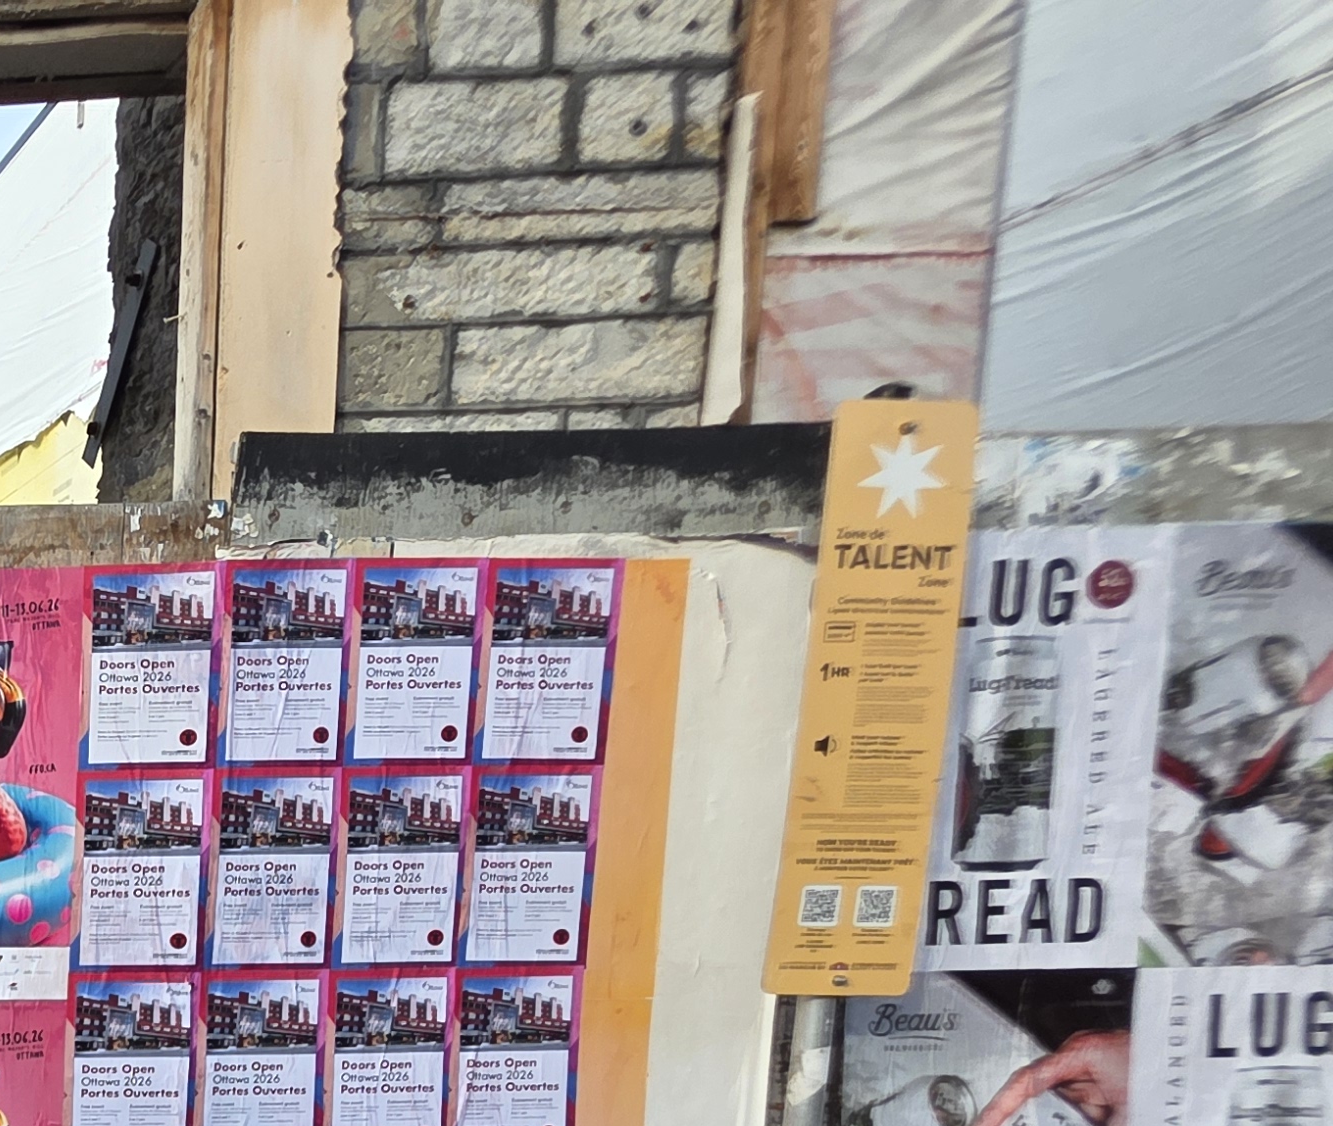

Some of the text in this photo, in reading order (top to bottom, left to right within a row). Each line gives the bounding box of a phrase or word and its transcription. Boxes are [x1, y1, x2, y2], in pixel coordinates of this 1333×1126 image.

[837, 528, 867, 539] Zone
[834, 544, 955, 570] TALENT
[918, 575, 949, 587] Zone
[958, 559, 1075, 627] UG
[99, 659, 175, 671] Doors Open
[367, 654, 439, 667] Doors Open
[99, 671, 172, 683] Ottawa 2026
[366, 666, 436, 677] Ottawa 2026
[831, 667, 850, 678] HR
[99, 684, 201, 695] Portes Ouvertes
[365, 679, 462, 690] Portes Ouvertes
[868, 1003, 959, 1036] Beau's
[81, 1064, 156, 1076] Doors Open
[81, 1076, 152, 1087] Ottawa 2026
[81, 1087, 179, 1098] Portes Ouvertes
